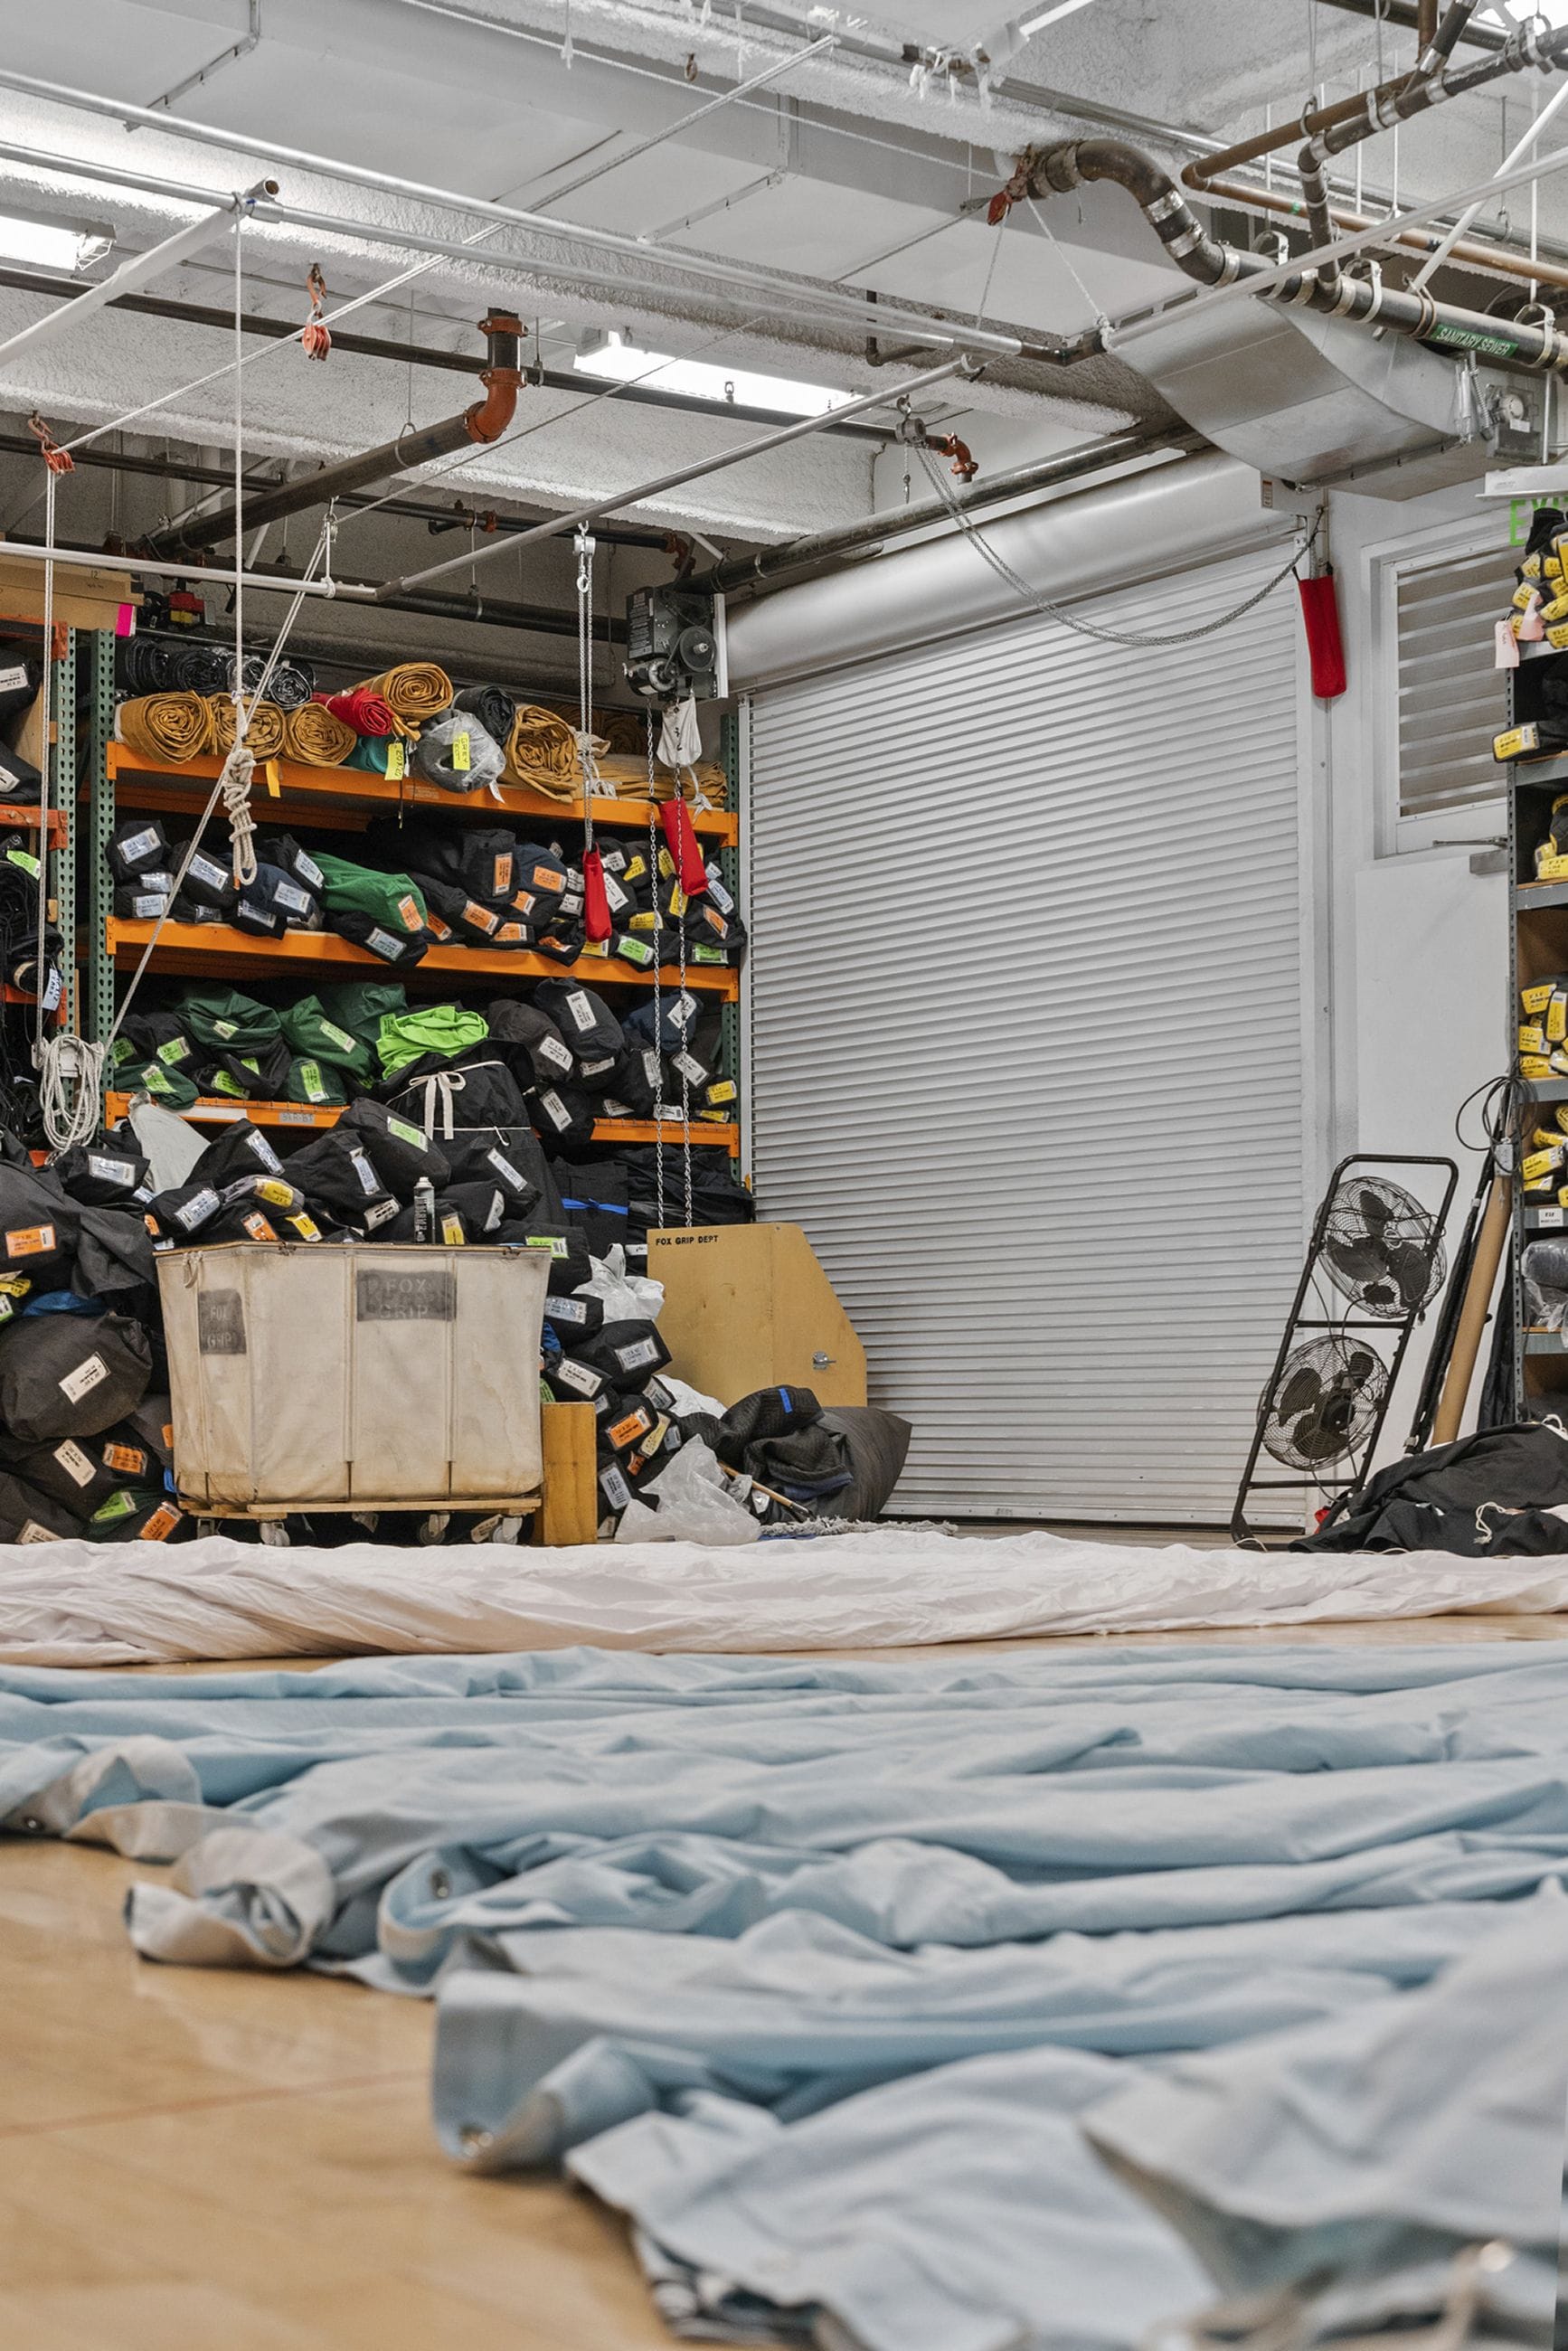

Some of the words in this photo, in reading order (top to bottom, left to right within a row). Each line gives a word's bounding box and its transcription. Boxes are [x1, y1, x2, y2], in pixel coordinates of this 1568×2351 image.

[1436, 327, 1482, 348] SANITARY
[1477, 338, 1511, 356] SEWER
[656, 1238, 672, 1246] FOX
[675, 1236, 694, 1245] GRIP
[698, 1234, 718, 1243] DEPT
[386, 1279, 427, 1293] FOX
[380, 1304, 429, 1319] GRIP
